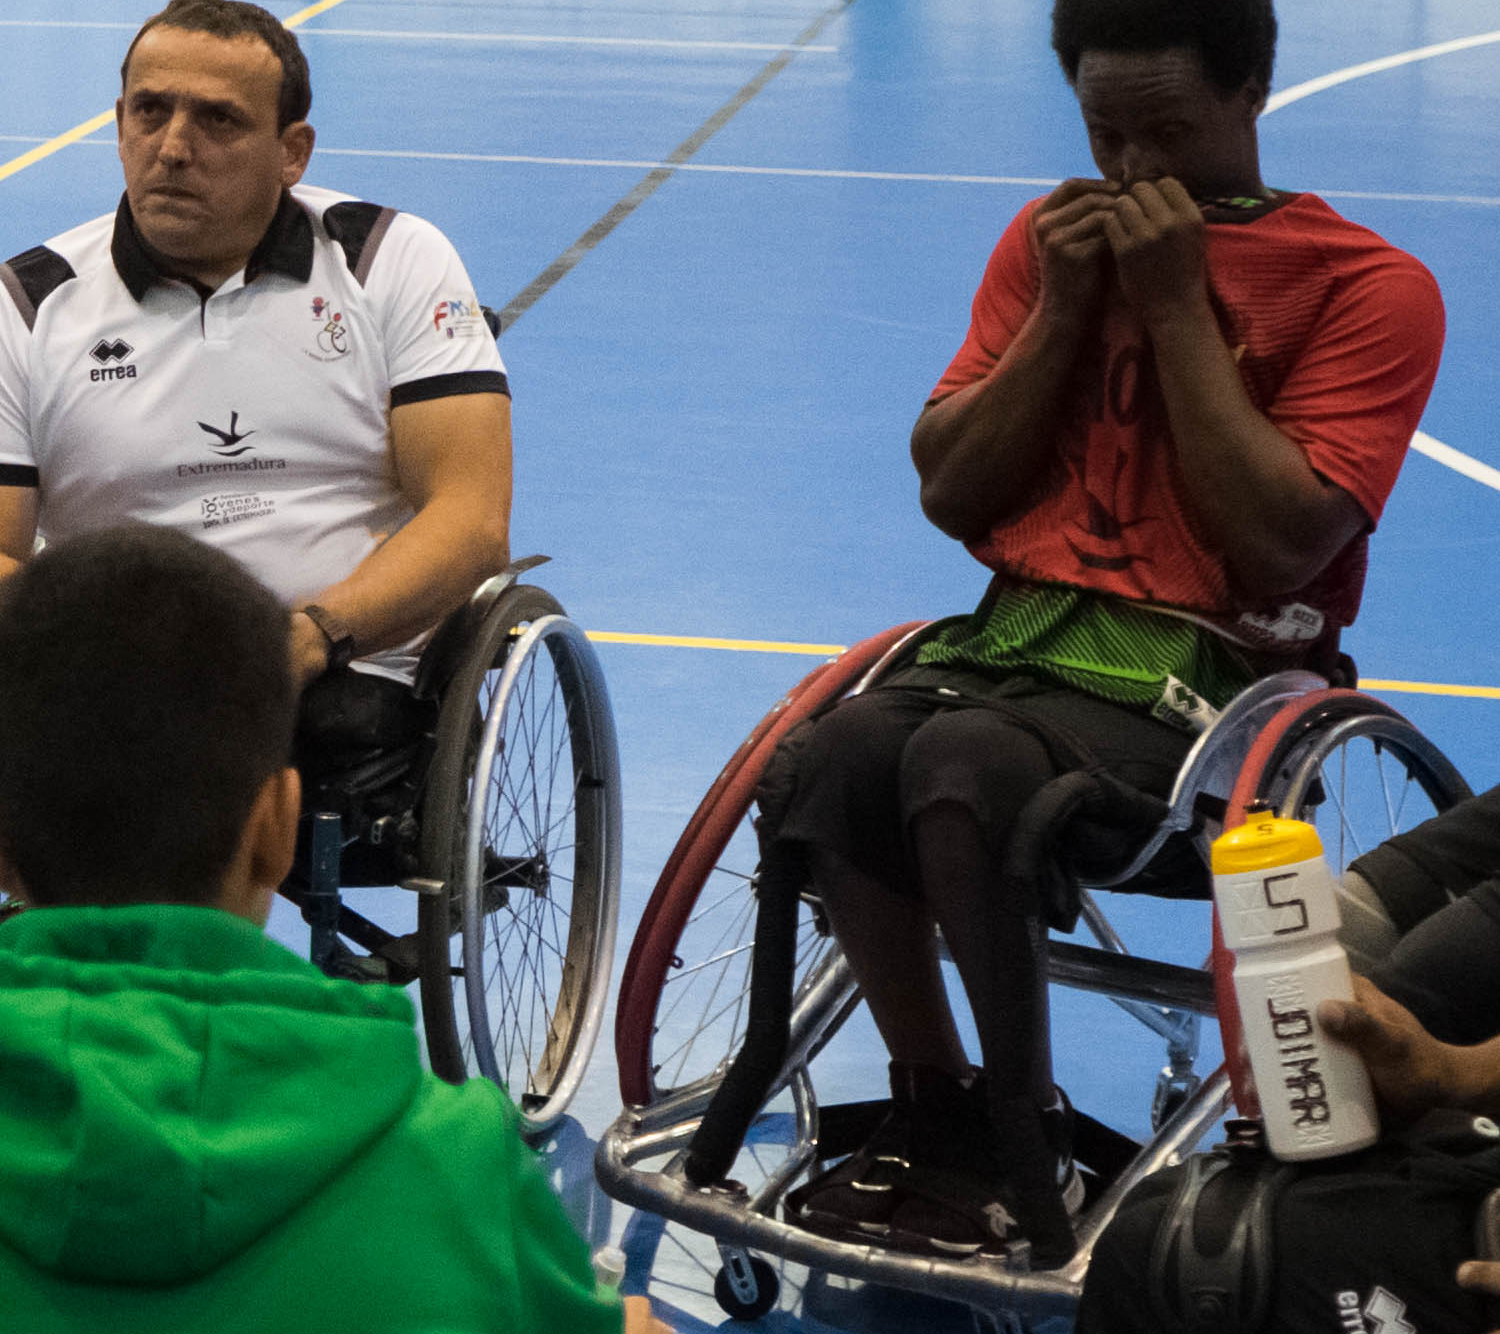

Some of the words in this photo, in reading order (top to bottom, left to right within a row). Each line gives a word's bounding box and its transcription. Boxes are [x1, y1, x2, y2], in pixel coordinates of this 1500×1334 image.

[89, 364, 138, 383] errea
[176, 457, 288, 478] Extremadura
[1262, 871, 1311, 936] 5
